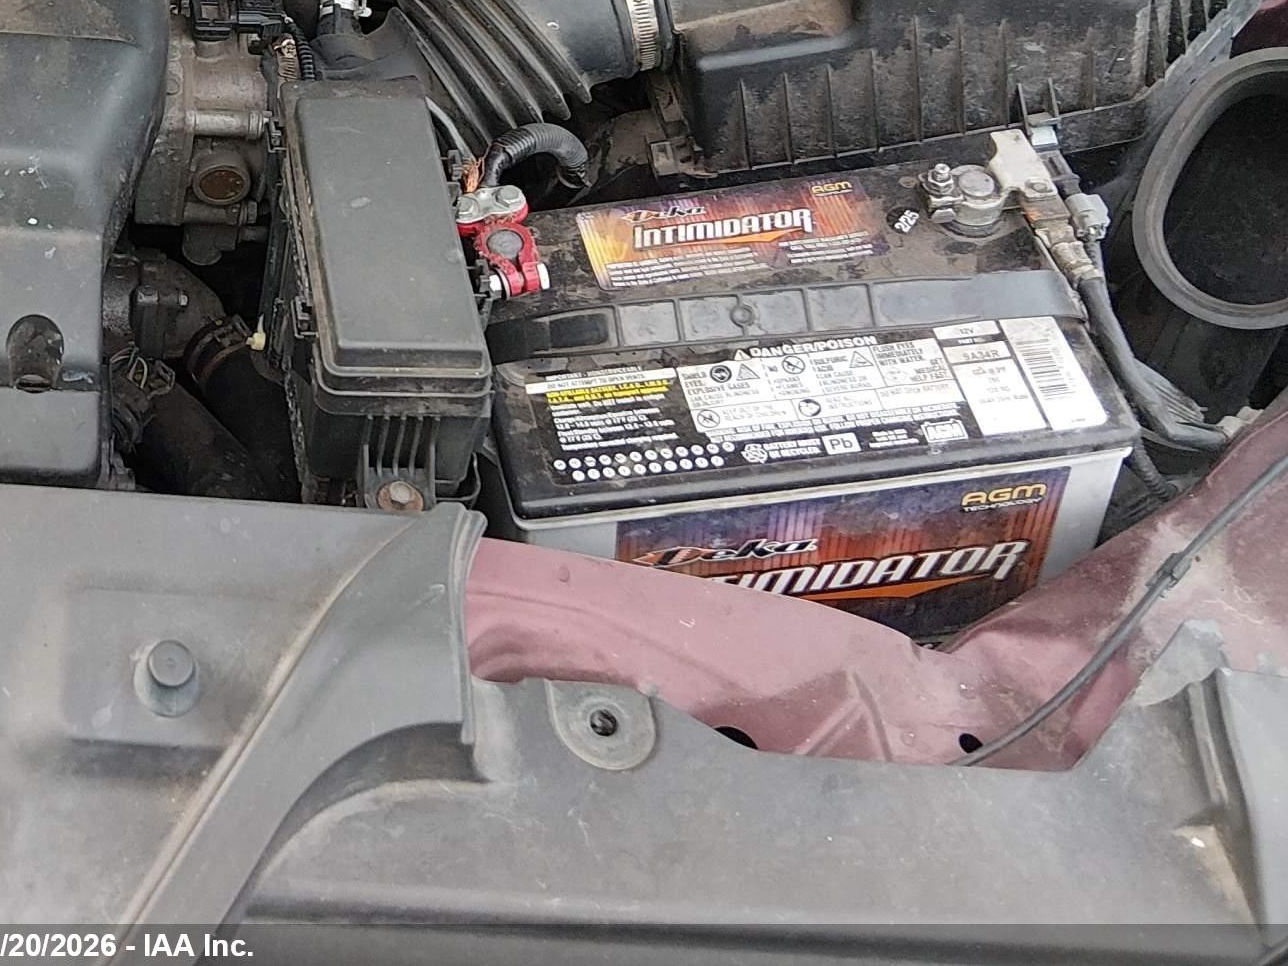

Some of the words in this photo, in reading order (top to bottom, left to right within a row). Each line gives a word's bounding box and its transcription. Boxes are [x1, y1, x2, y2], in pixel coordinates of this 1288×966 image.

[812, 181, 852, 194] AGM
[633, 208, 813, 248] INTIMIDATOR
[749, 335, 878, 357] DANGER/POISON
[830, 438, 854, 450] Pb
[961, 483, 1048, 506] AGM
[963, 497, 1043, 512] TECHNOLOGY
[712, 541, 1029, 594] MIDATOR
